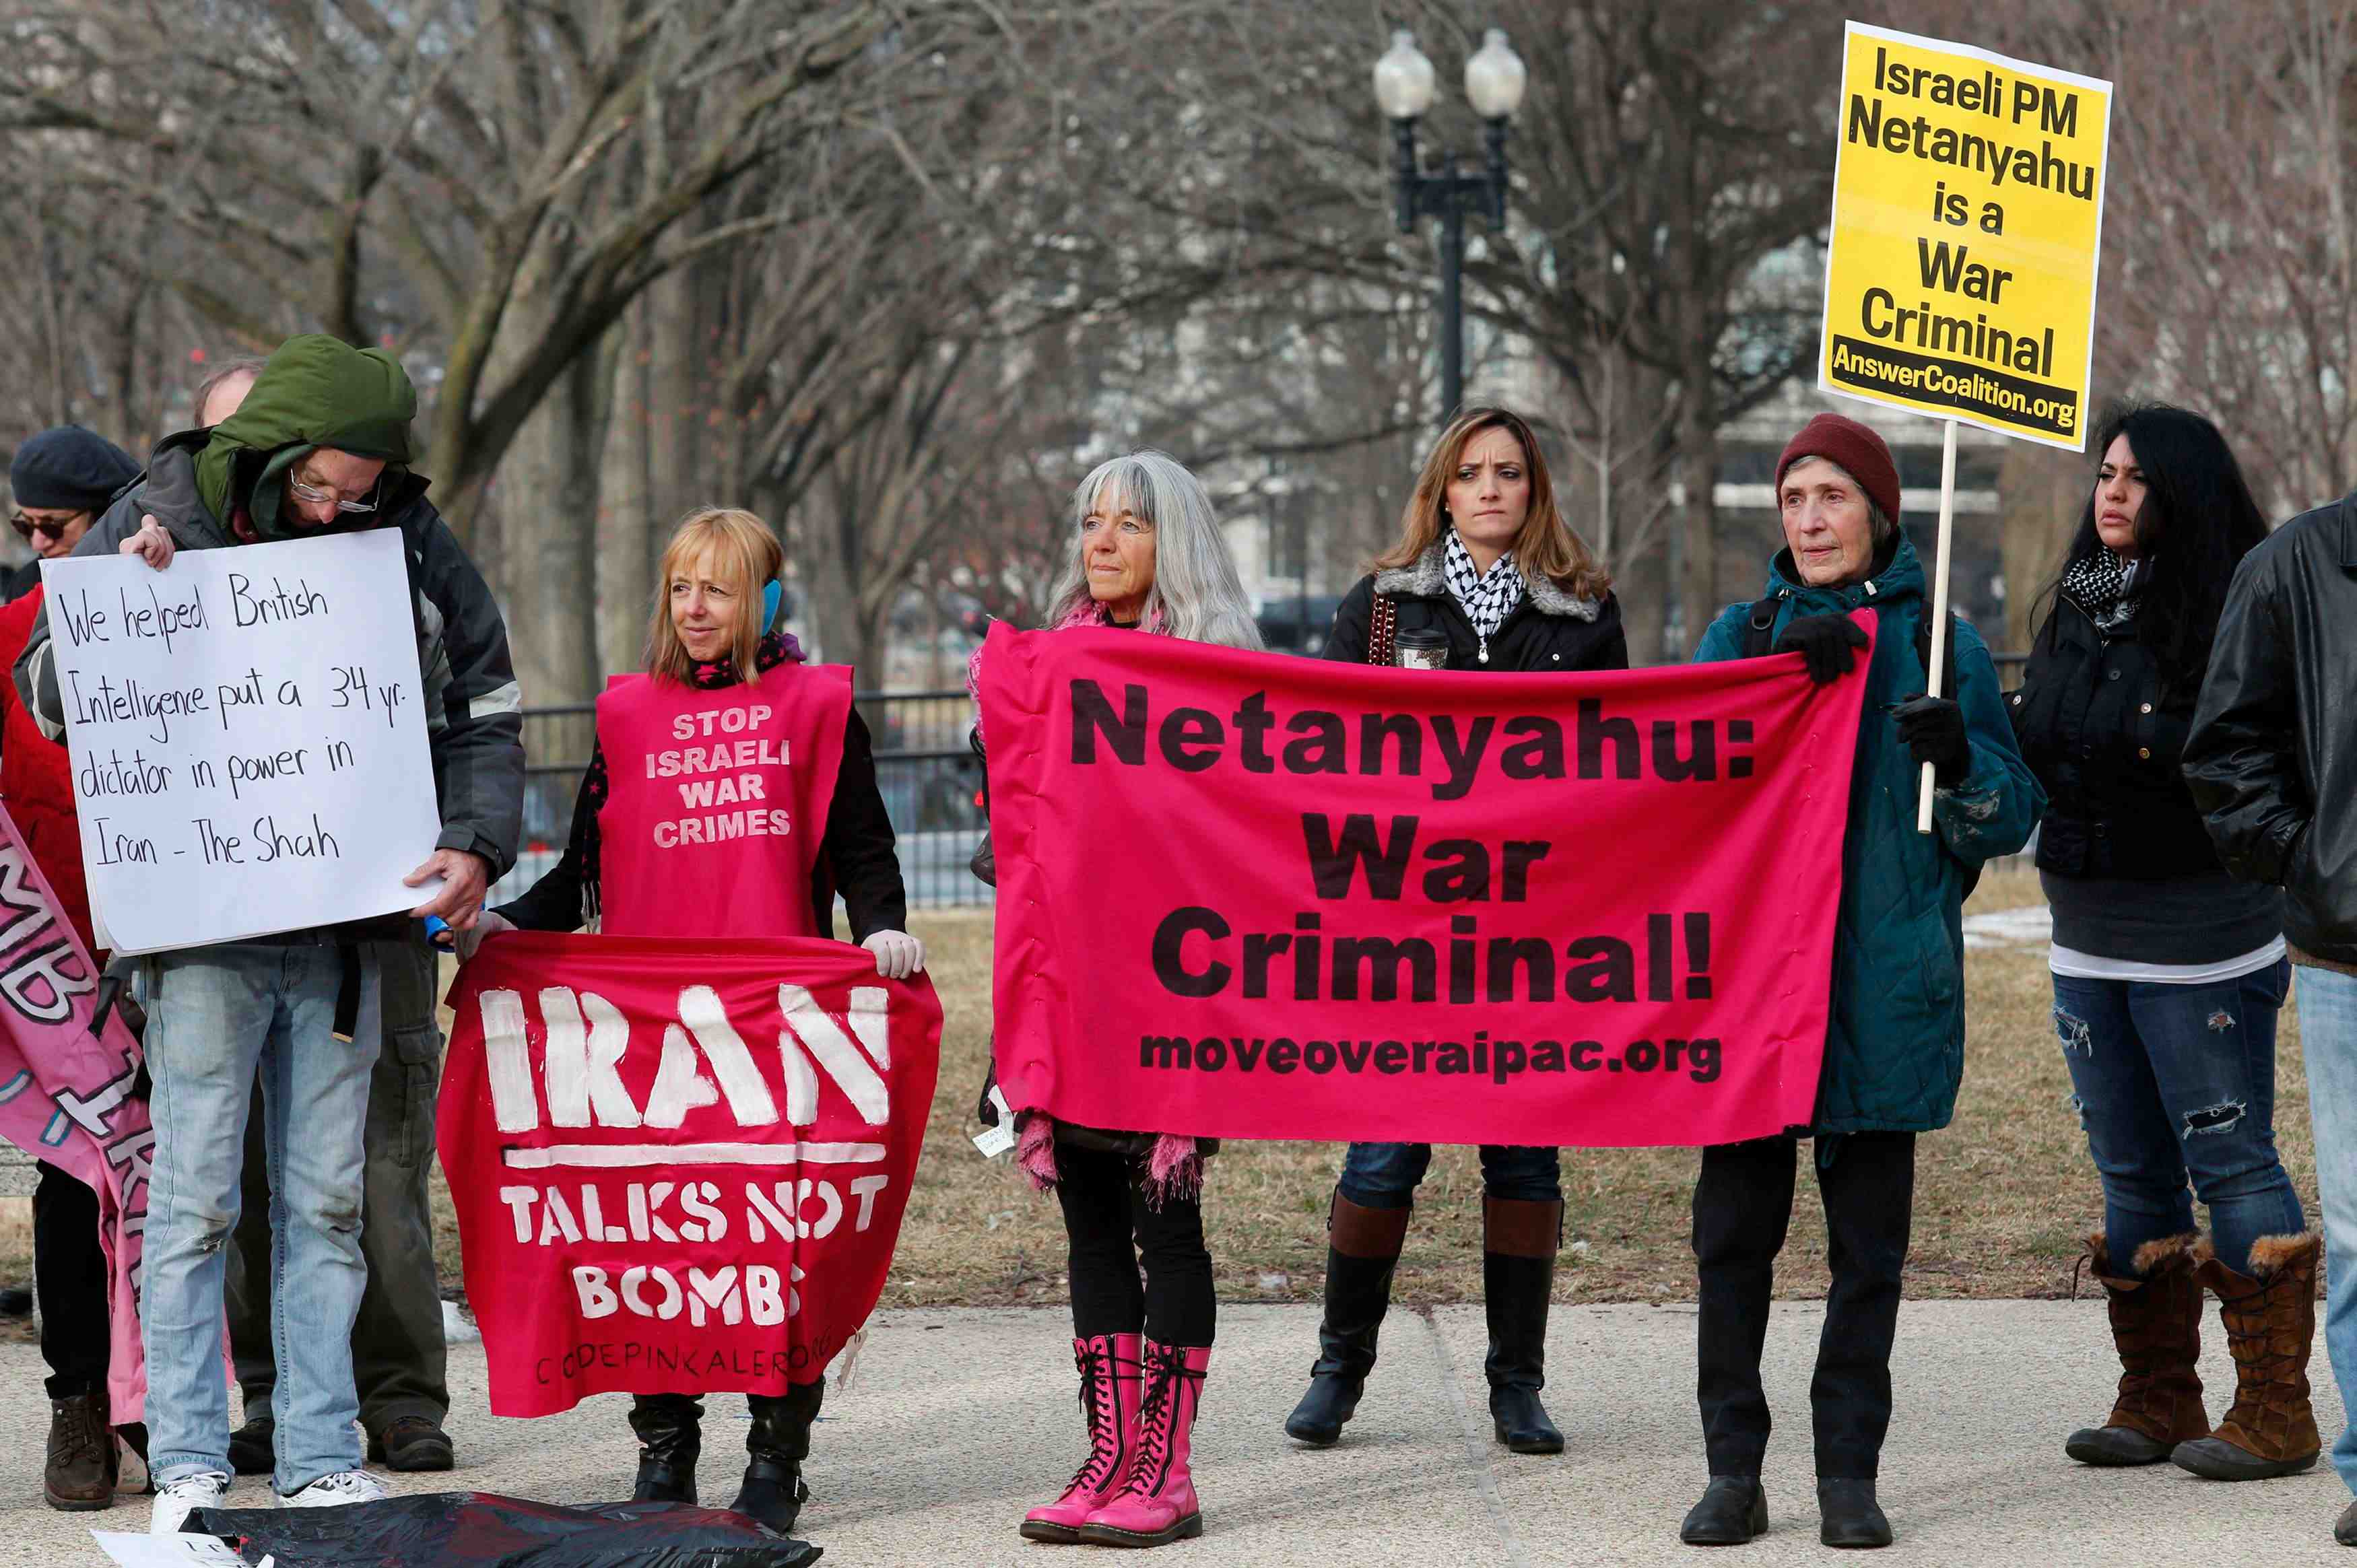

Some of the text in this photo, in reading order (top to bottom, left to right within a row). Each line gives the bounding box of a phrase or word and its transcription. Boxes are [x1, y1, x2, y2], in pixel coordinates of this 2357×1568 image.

[1874, 46, 2078, 138] Israeli PM
[1848, 94, 2094, 201] Netanyahu
[1933, 181, 2003, 236] is a
[1917, 237, 2013, 305] War
[1861, 287, 2055, 378] Criminal
[1832, 343, 2076, 429] AnswerCoalition.org
[59, 574, 328, 654] We helped British
[68, 666, 406, 743] Intelligence put a 34 yr.
[672, 705, 772, 741] STOP
[1069, 677, 1754, 801] Netanyahu:
[80, 737, 355, 800] dictator in power in
[645, 739, 791, 779] ISRAELI
[678, 772, 766, 809] WAR
[94, 817, 158, 865] Iran
[191, 818, 244, 864] The
[253, 813, 340, 862] Shah
[653, 809, 791, 848] CRIMES
[1301, 813, 1552, 904] War
[1152, 906, 1713, 1004] Criminal!
[479, 982, 891, 1134] IRAN
[1139, 1030, 1722, 1085] moveoveraipac.org
[500, 1174, 888, 1246] TALKS NOT
